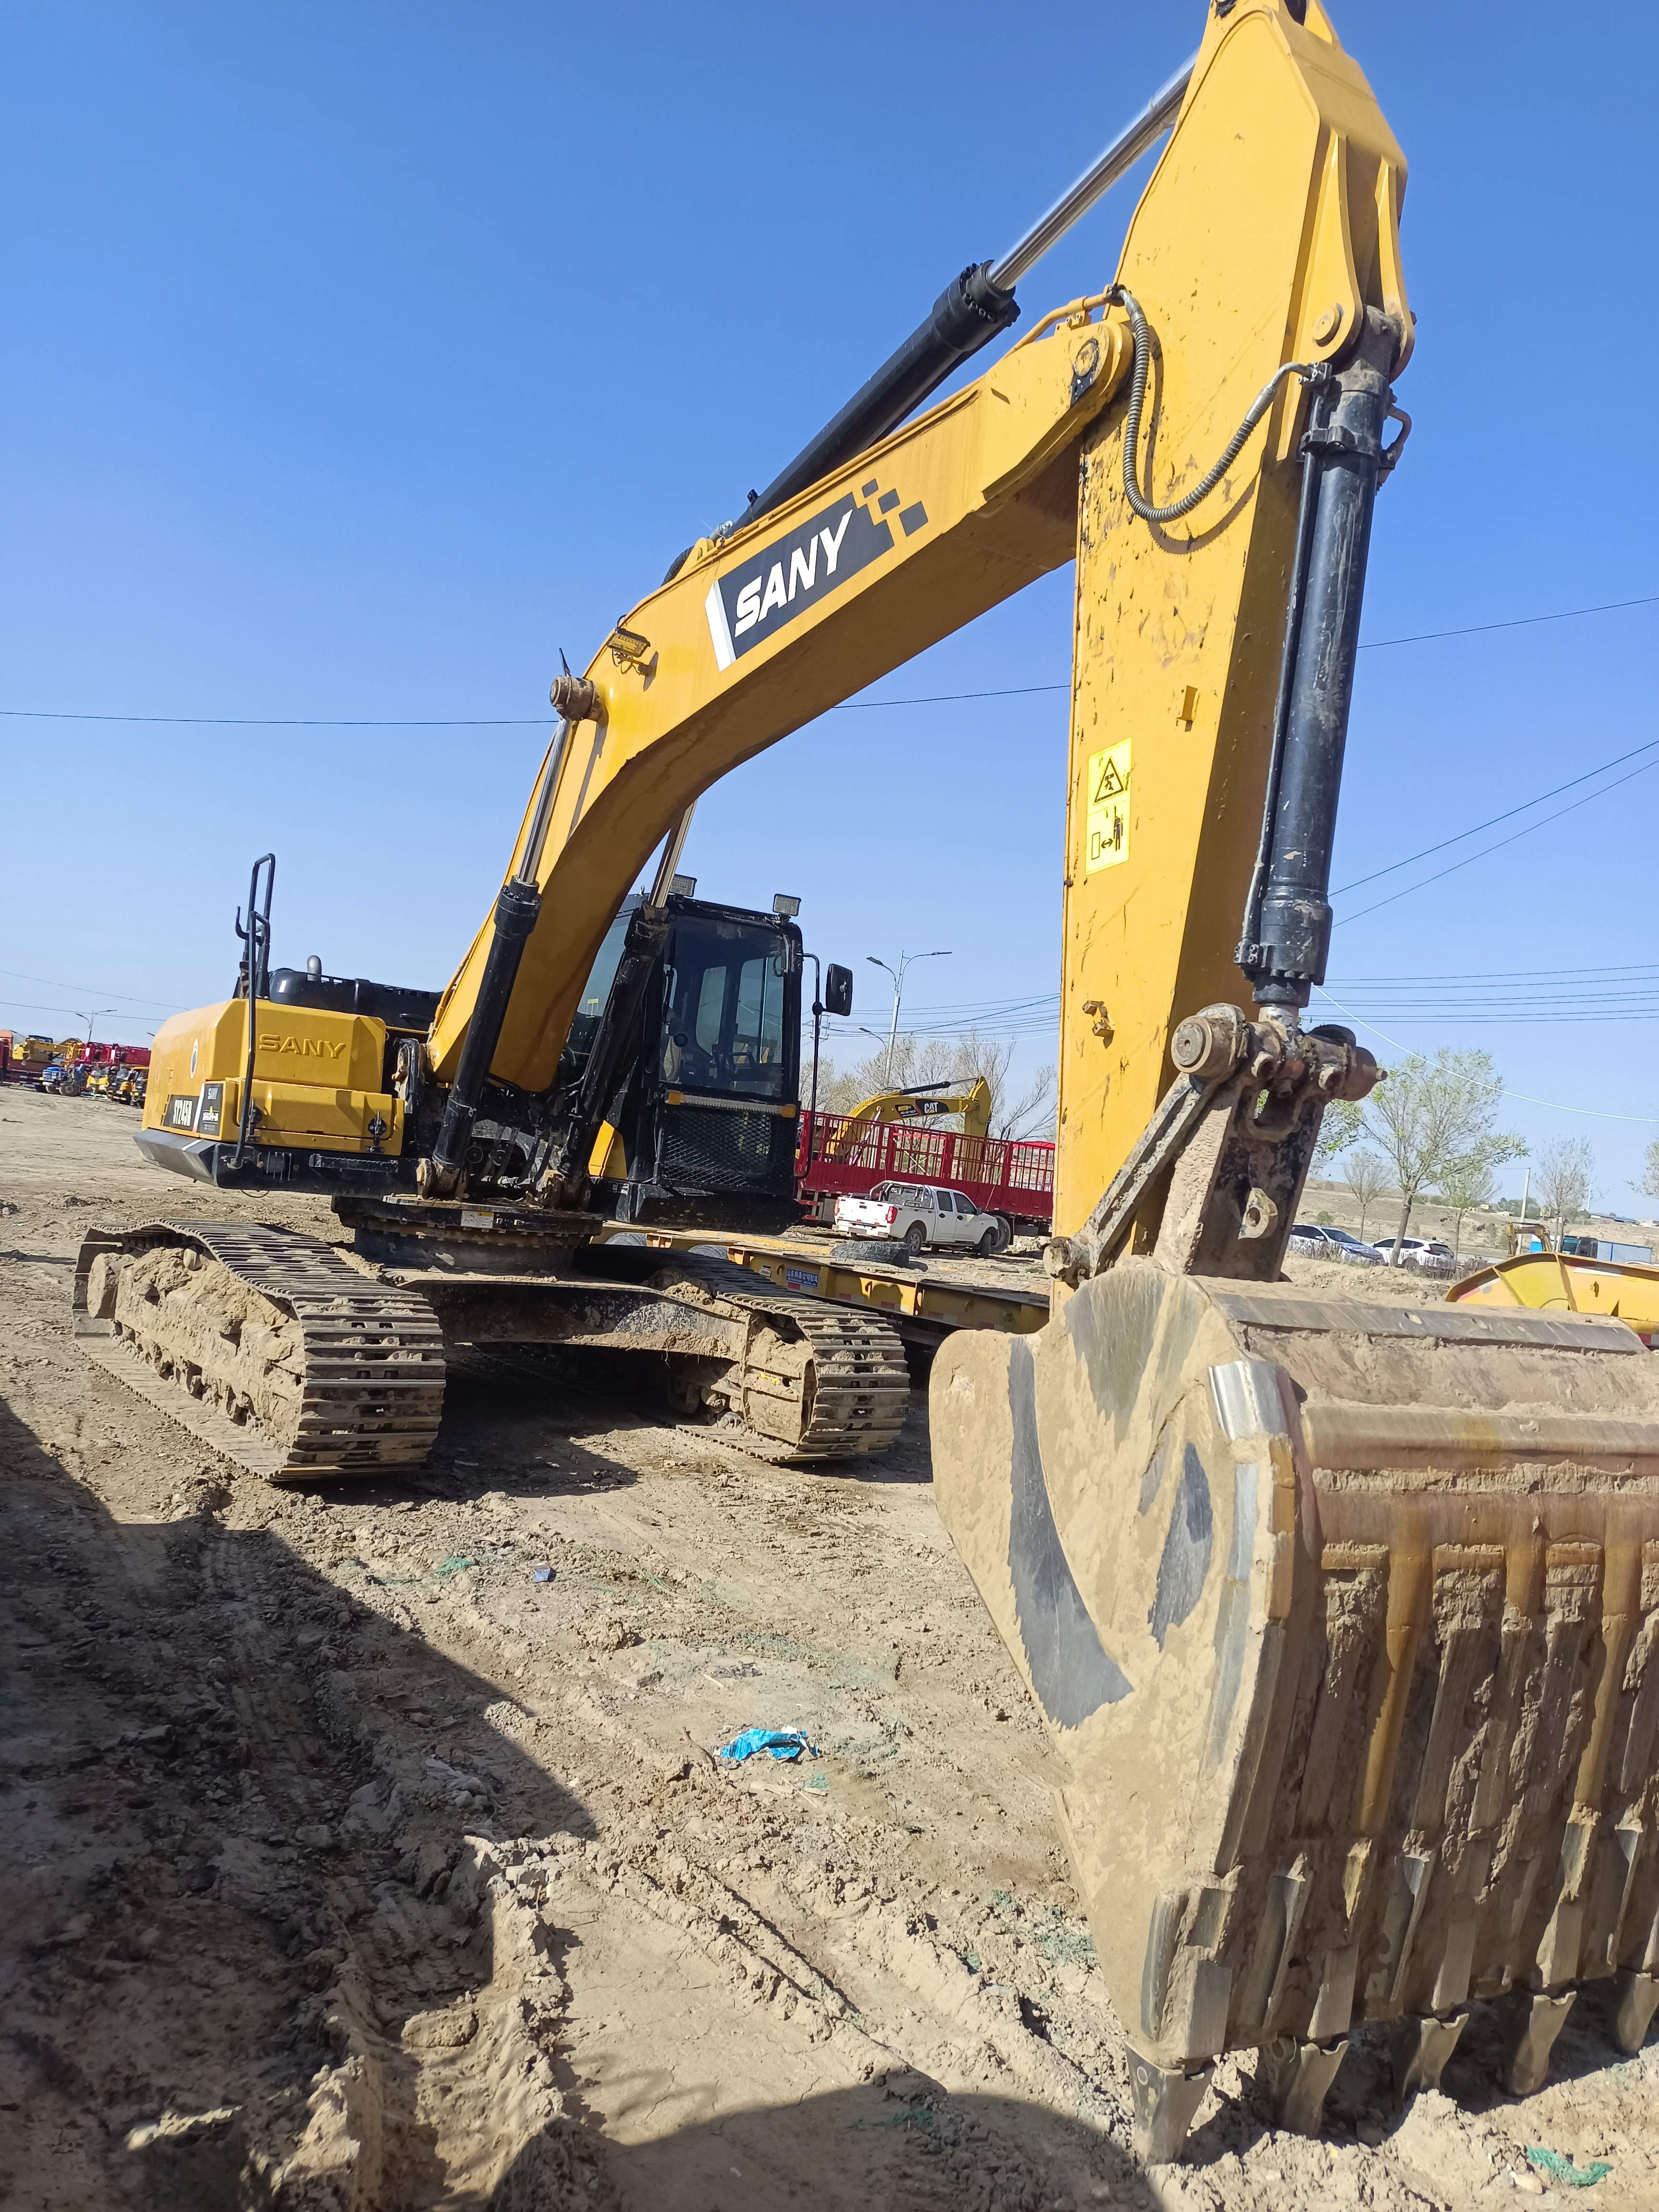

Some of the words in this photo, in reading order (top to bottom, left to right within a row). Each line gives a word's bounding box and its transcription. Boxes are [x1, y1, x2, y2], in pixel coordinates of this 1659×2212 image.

[735, 509, 853, 637] SANY
[259, 1034, 346, 1059] SANY
[924, 1102, 938, 1114] CAT
